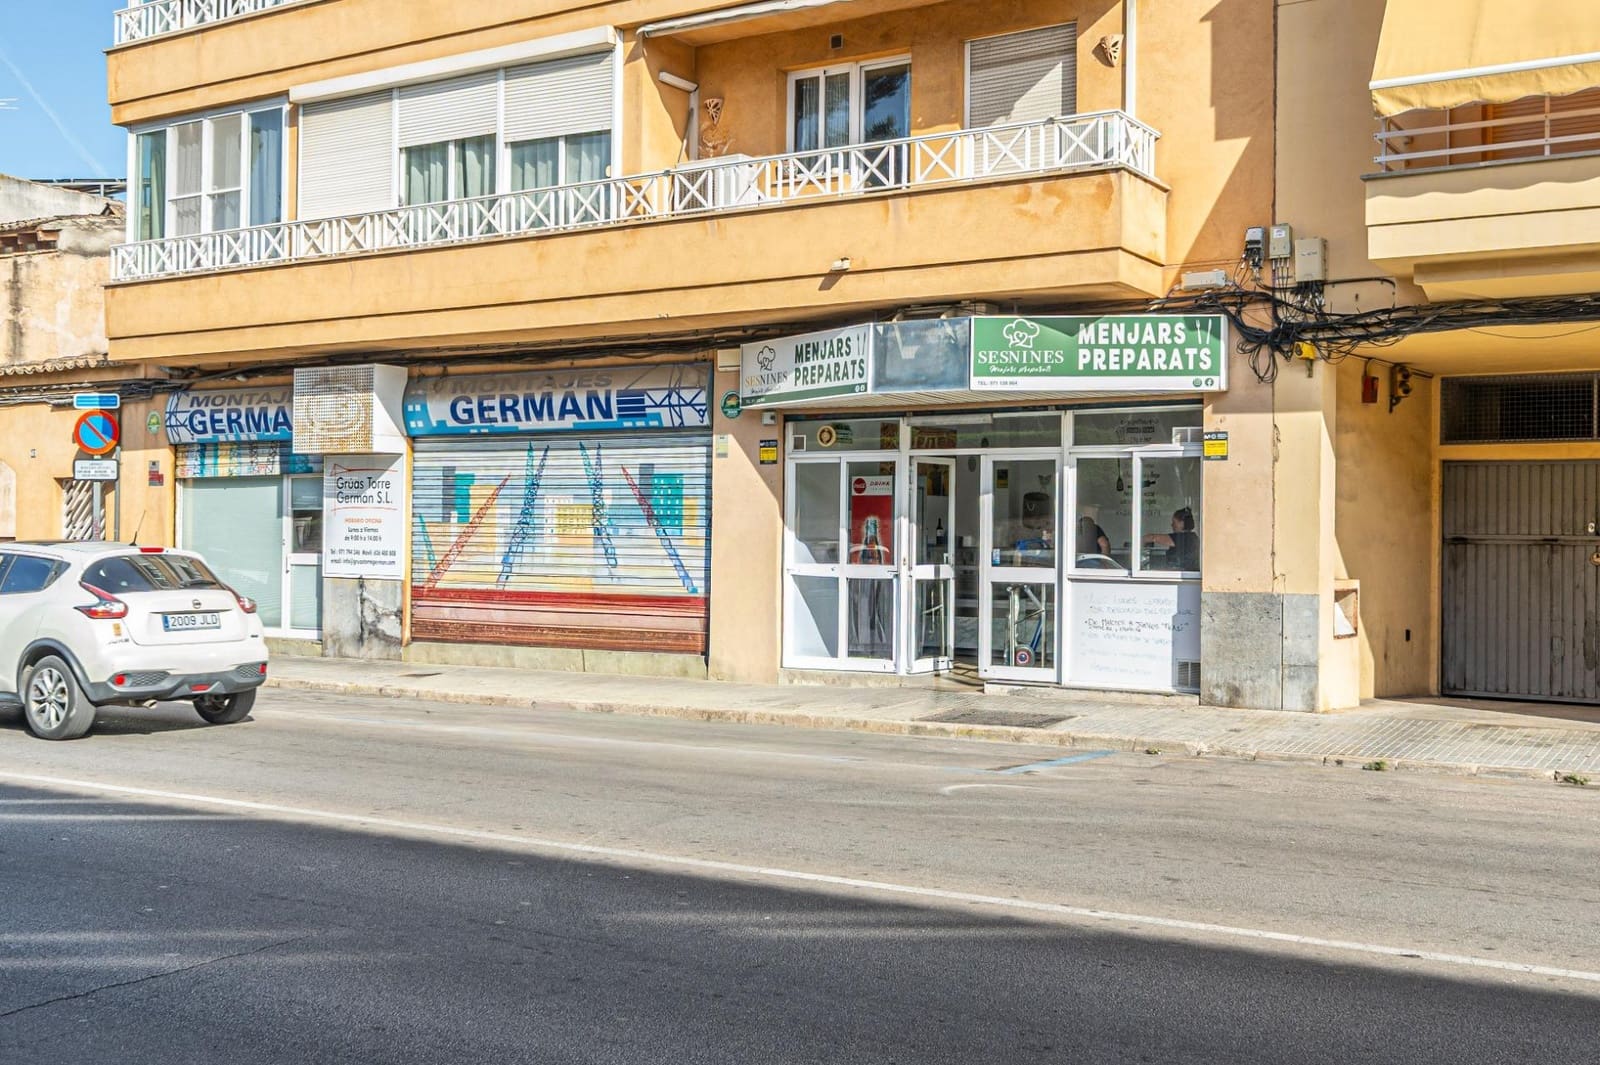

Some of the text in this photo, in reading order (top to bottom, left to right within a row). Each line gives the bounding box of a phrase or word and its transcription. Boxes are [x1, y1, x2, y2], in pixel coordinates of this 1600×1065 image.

[1078, 322, 1186, 344] MENJARS
[795, 336, 852, 364] MENJARS
[978, 350, 1064, 364] SESNINES
[1078, 347, 1212, 370] PREPARATS
[745, 371, 788, 388] SESNINES
[794, 358, 865, 386] PREPARATS
[451, 374, 613, 394] MONTAJES
[450, 389, 614, 424] GERMAN
[336, 477, 391, 489] Grúas Torre
[336, 491, 393, 504] German S.L.
[171, 614, 218, 627] 2009 JLD
